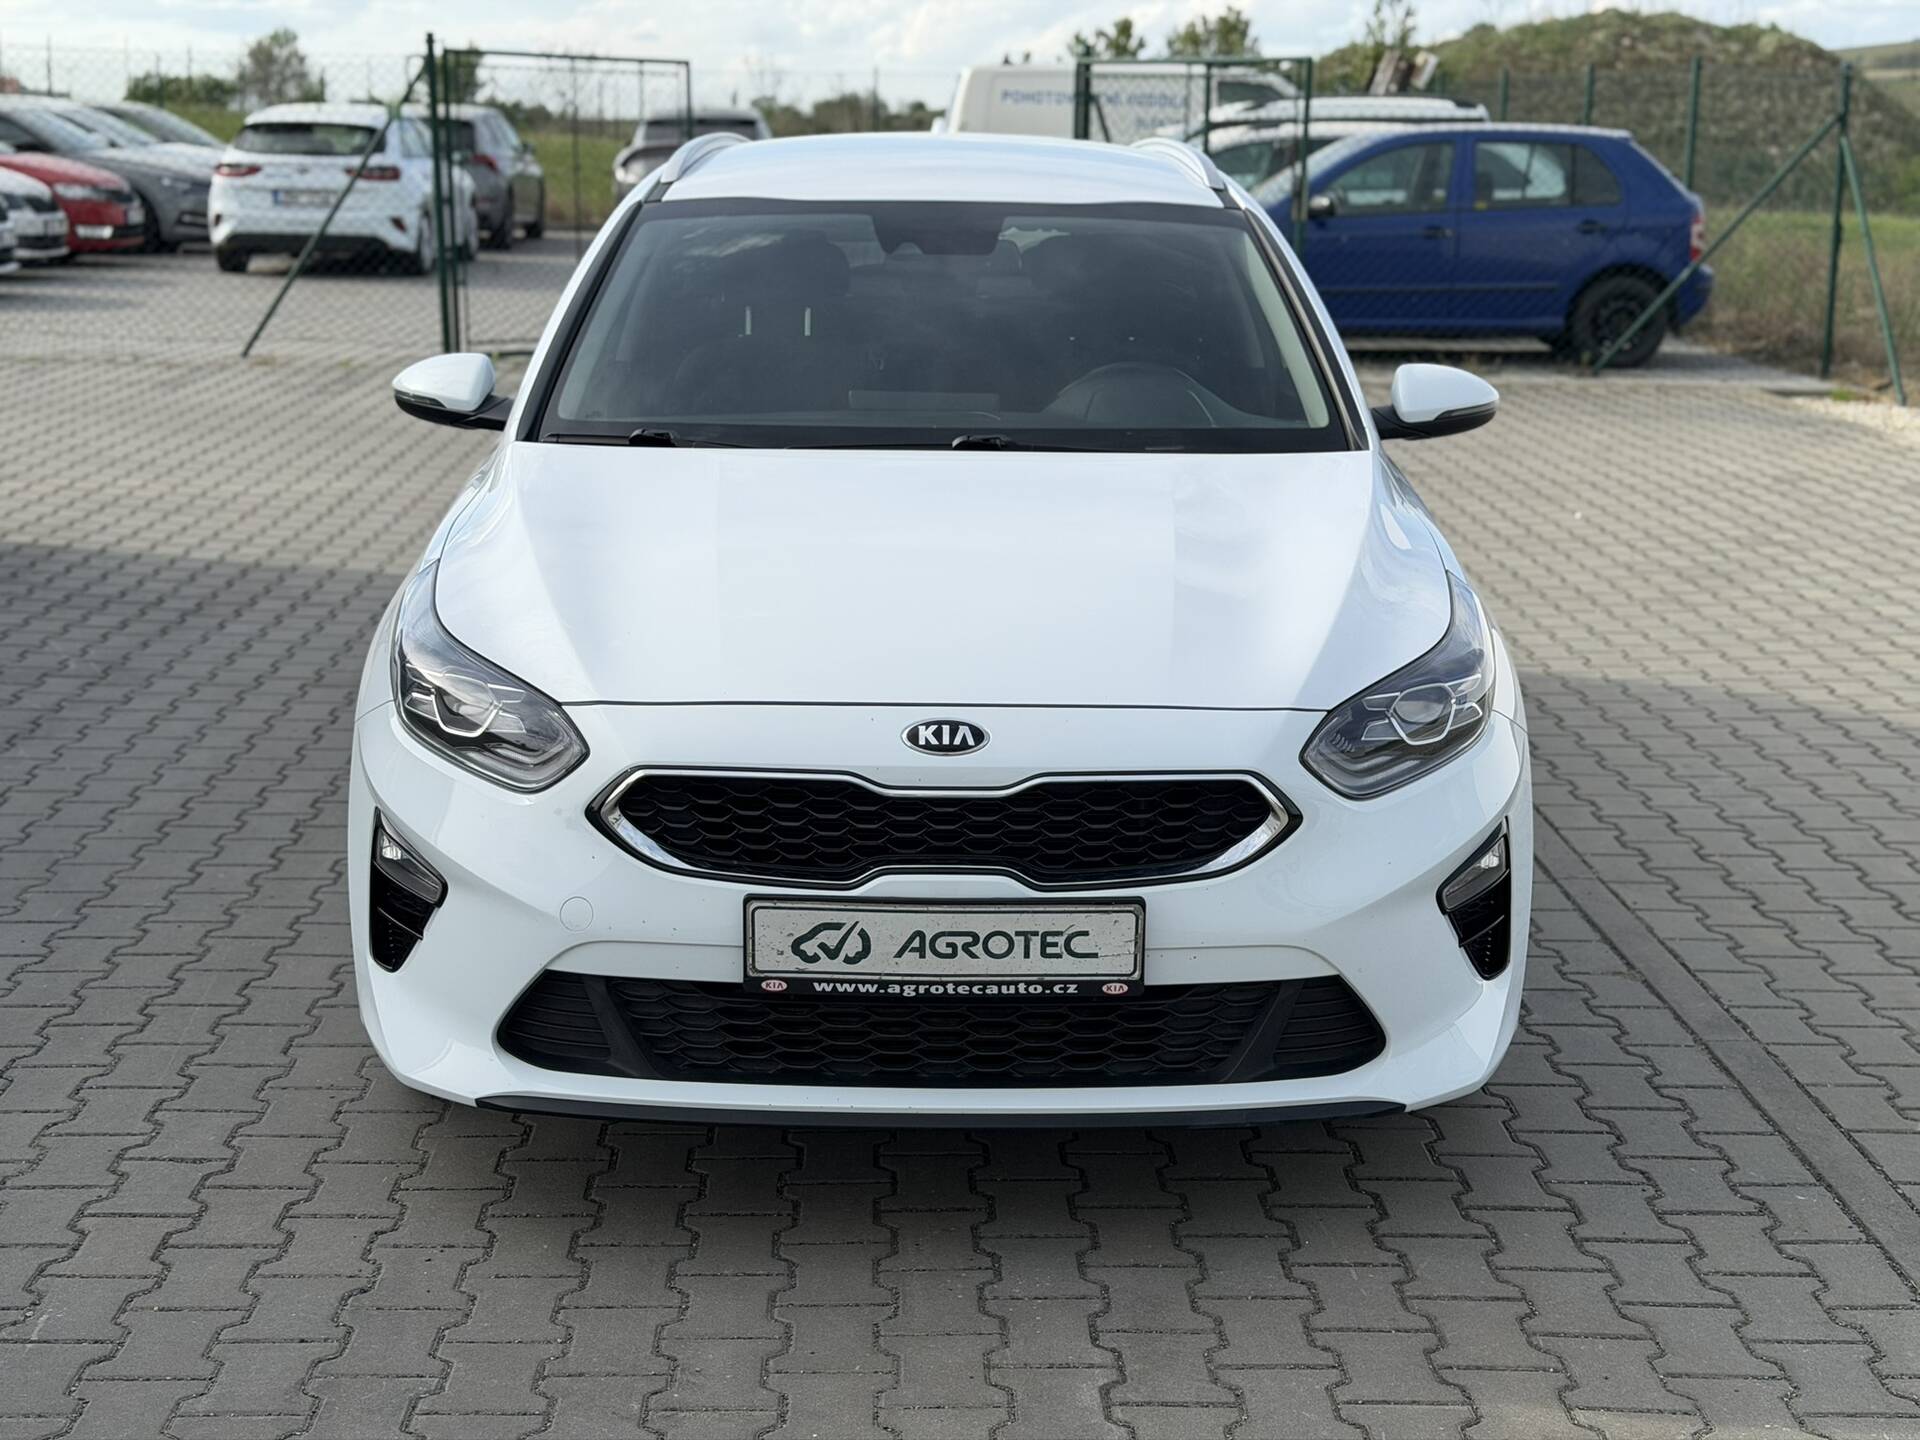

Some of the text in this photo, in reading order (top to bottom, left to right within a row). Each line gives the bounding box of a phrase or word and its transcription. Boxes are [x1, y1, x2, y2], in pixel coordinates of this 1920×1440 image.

[917, 724, 976, 746] KIA
[892, 929, 1099, 960] AGROTEC
[764, 980, 786, 991] KIA
[812, 981, 1079, 997] www.agrotecauto.cz
[1105, 982, 1128, 993] KIA
